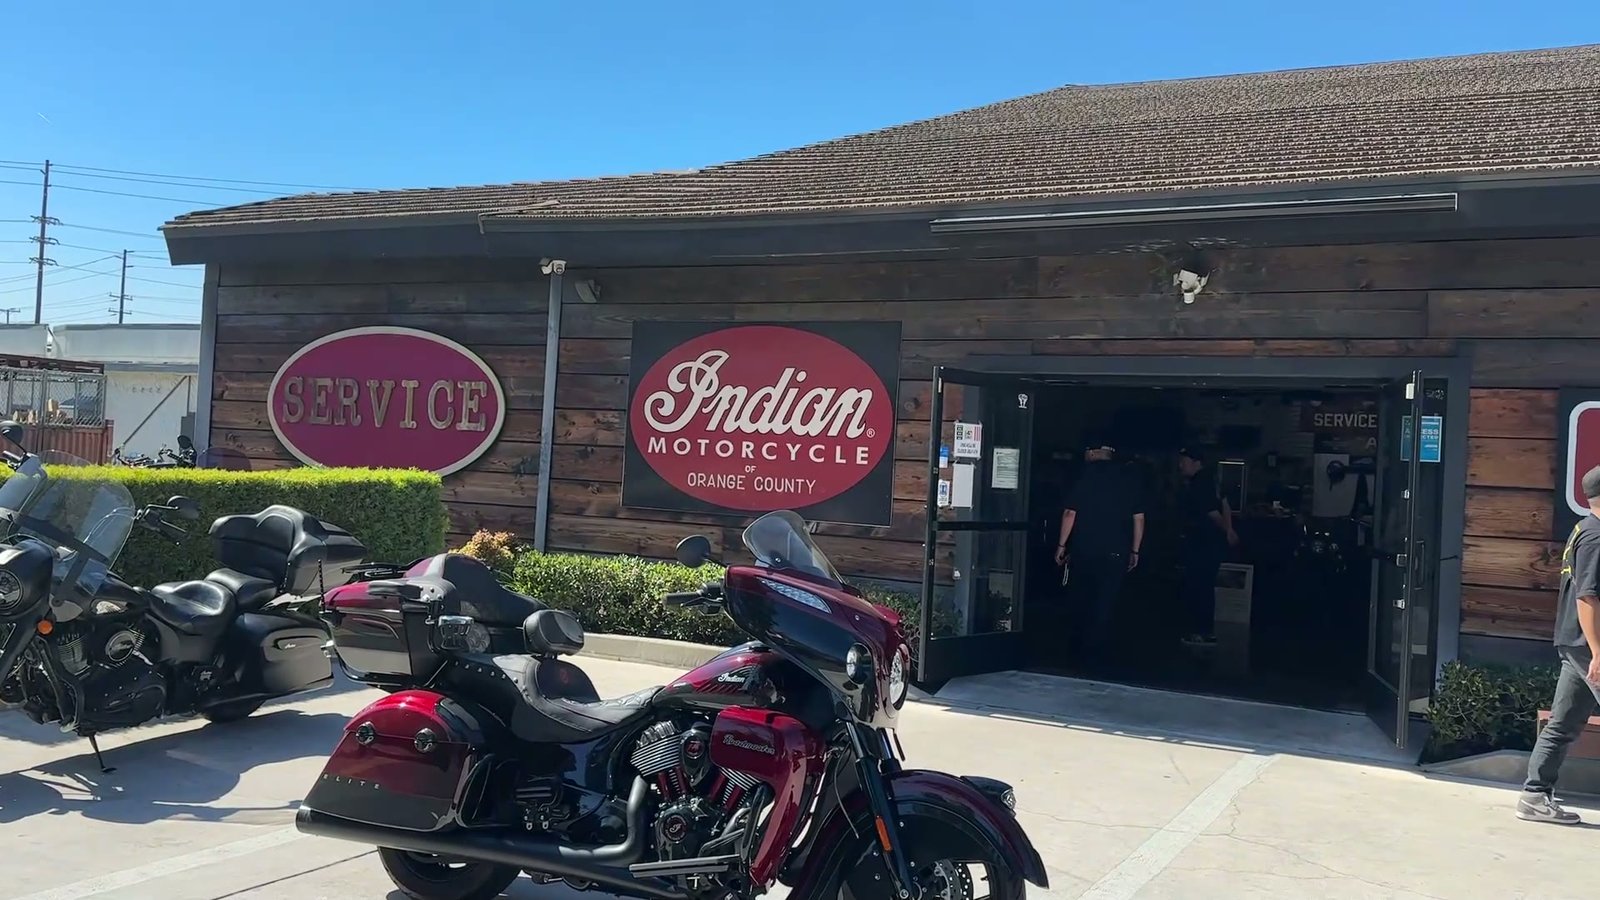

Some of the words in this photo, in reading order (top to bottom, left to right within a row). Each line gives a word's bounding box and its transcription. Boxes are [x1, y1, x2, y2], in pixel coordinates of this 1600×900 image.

[282, 376, 488, 431] SERVICE
[644, 350, 873, 438] Indian
[1313, 413, 1377, 428] SERVICE
[648, 437, 869, 465] MOTORCYCLE
[745, 465, 757, 474] OF
[687, 472, 746, 490] ORANGE
[754, 476, 816, 494] COUNTY
[718, 672, 746, 683] Indian
[323, 773, 380, 790] ELITE
